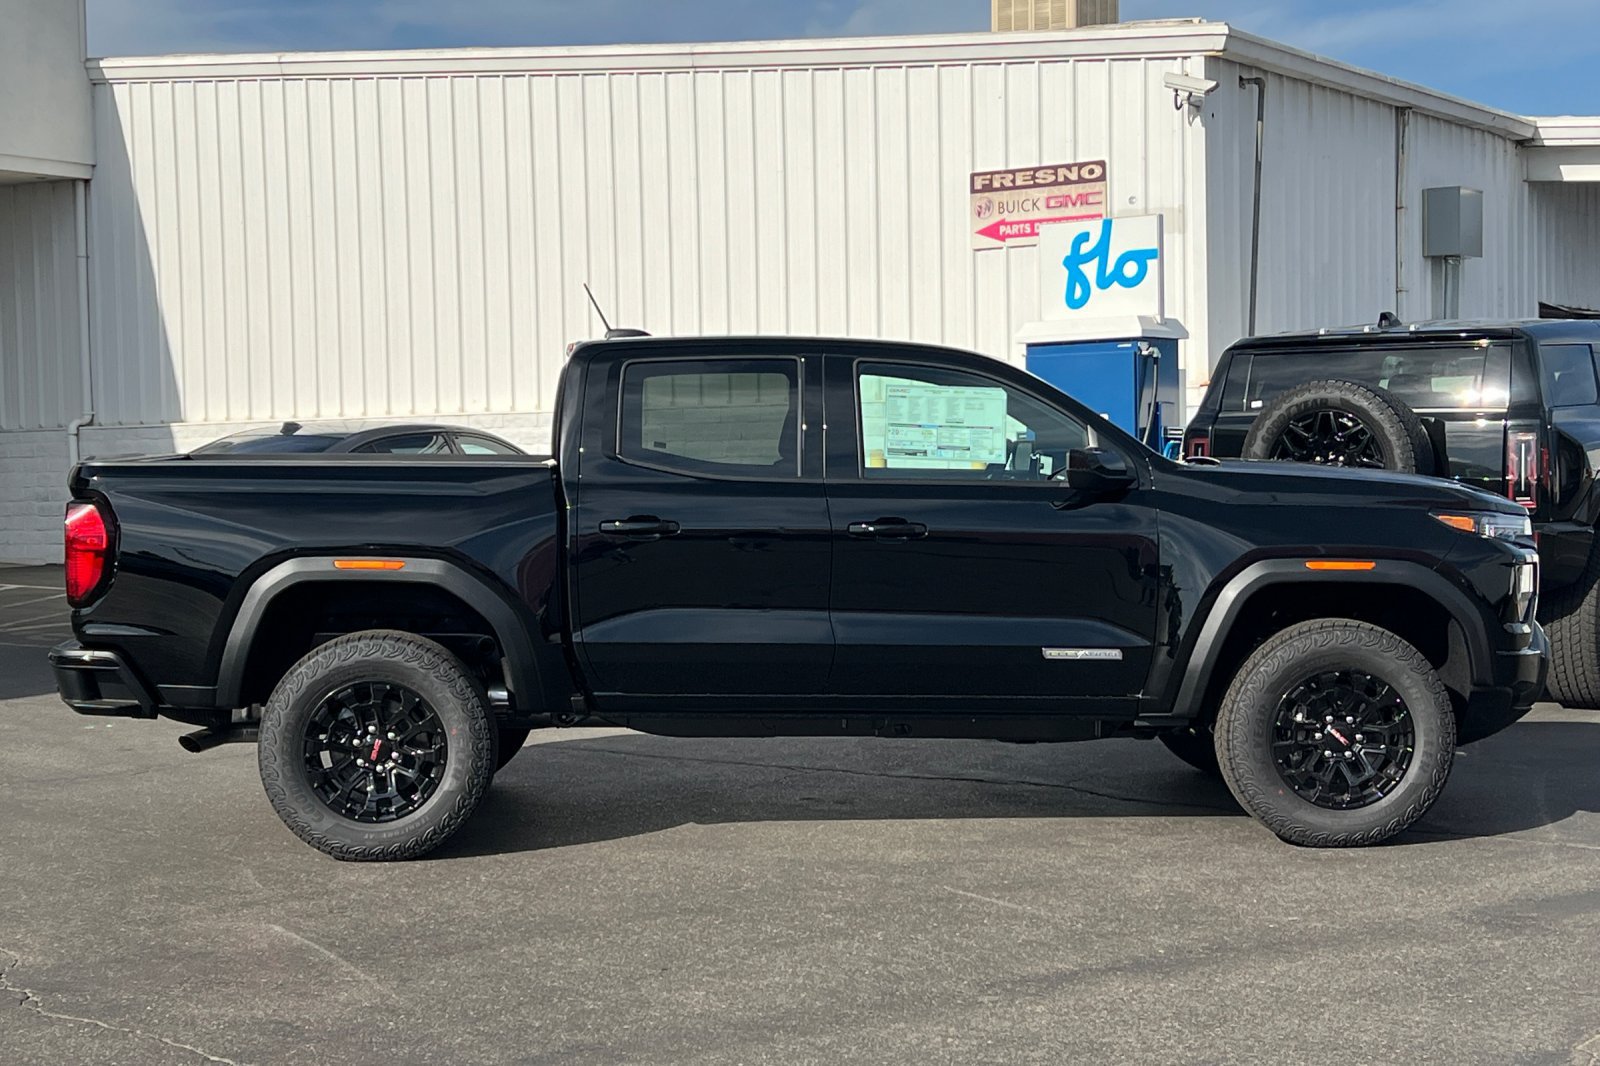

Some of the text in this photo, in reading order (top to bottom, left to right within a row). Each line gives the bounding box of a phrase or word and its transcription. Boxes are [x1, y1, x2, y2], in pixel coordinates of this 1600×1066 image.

[973, 163, 1103, 190] FRESNO
[997, 191, 1103, 214] BUICK GMC
[999, 223, 1031, 236] PARTS
[1063, 218, 1158, 310] flo
